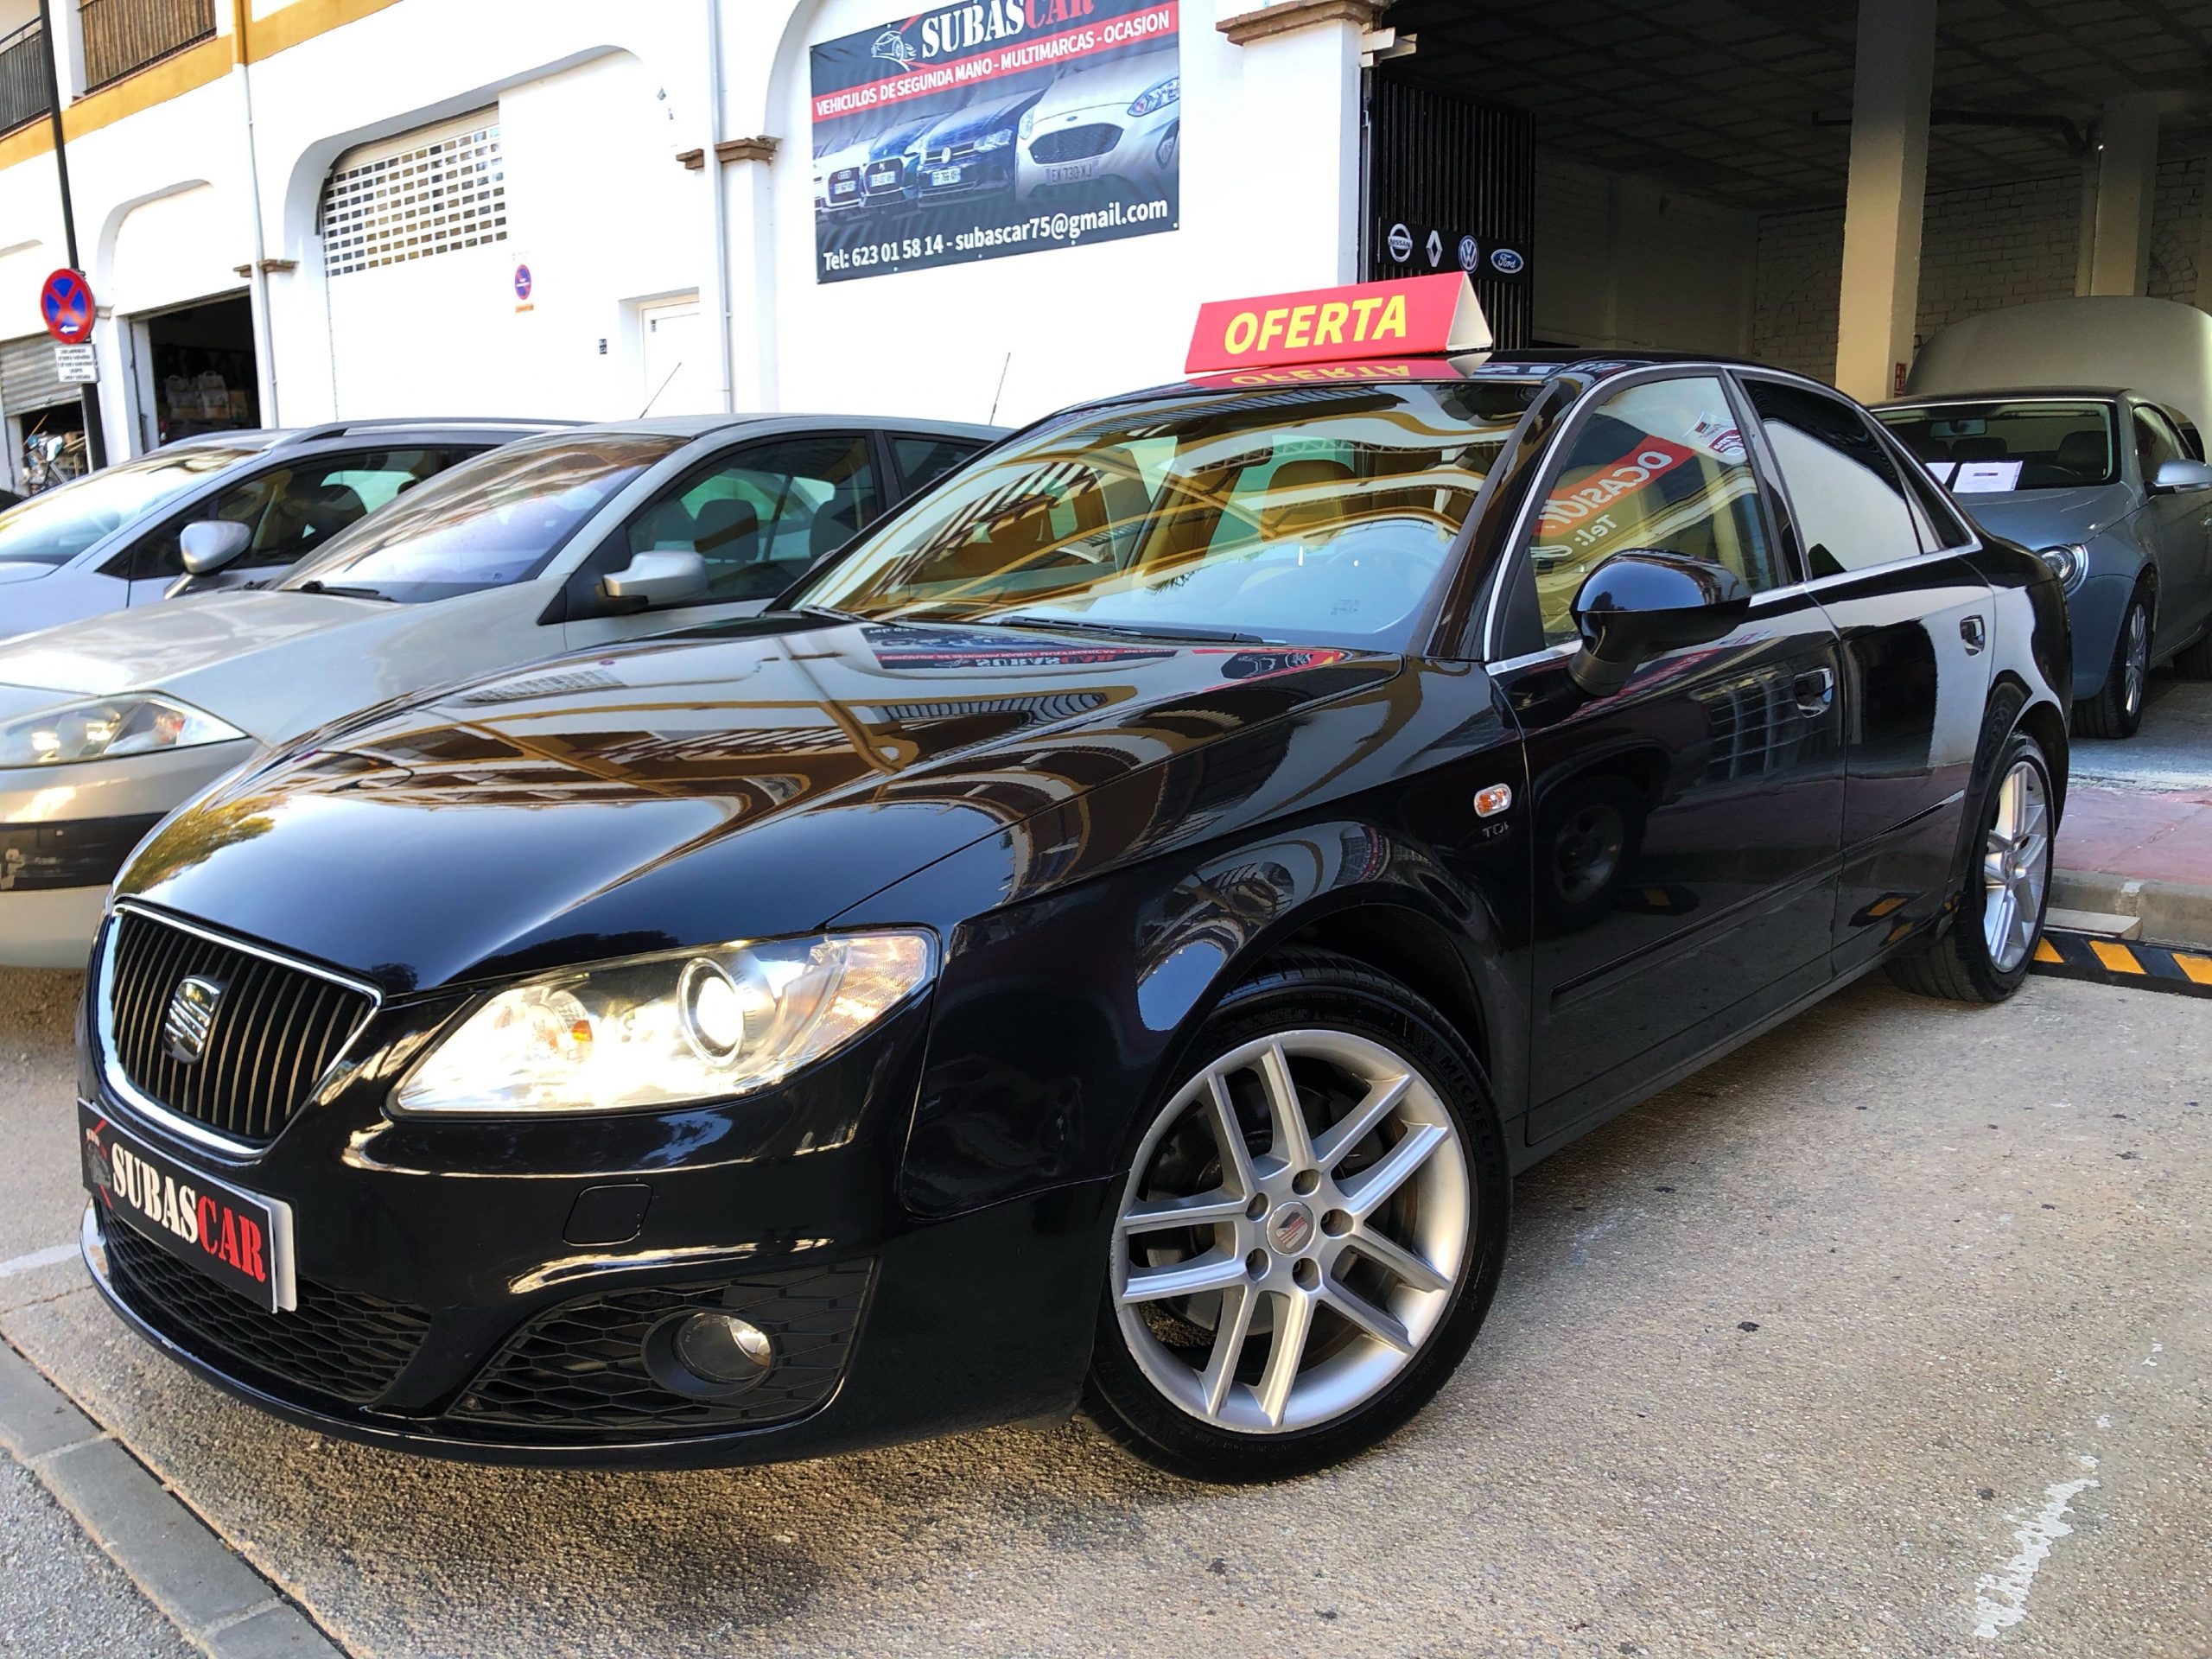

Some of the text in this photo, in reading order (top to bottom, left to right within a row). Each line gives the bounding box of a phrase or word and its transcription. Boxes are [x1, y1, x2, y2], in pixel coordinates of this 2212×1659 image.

[816, 88, 877, 117] VEHICULOS
[880, 85, 896, 101] DE
[897, 70, 954, 96] SEGUNDA
[955, 58, 992, 82] MANO
[1001, 30, 1095, 71] MULTIMARCAS
[1104, 10, 1170, 43] OCASION
[823, 249, 849, 270] Tel:
[852, 245, 879, 267] 623
[880, 242, 899, 263] 01
[902, 238, 921, 259] 58
[924, 234, 944, 256] 14
[955, 200, 1168, 251] subascar75@gmail.com
[1389, 238, 1411, 248] NISSAN
[1497, 252, 1516, 269] Ford
[1224, 295, 1408, 355] OFERTA
[111, 1141, 266, 1283] SUBASCAR
